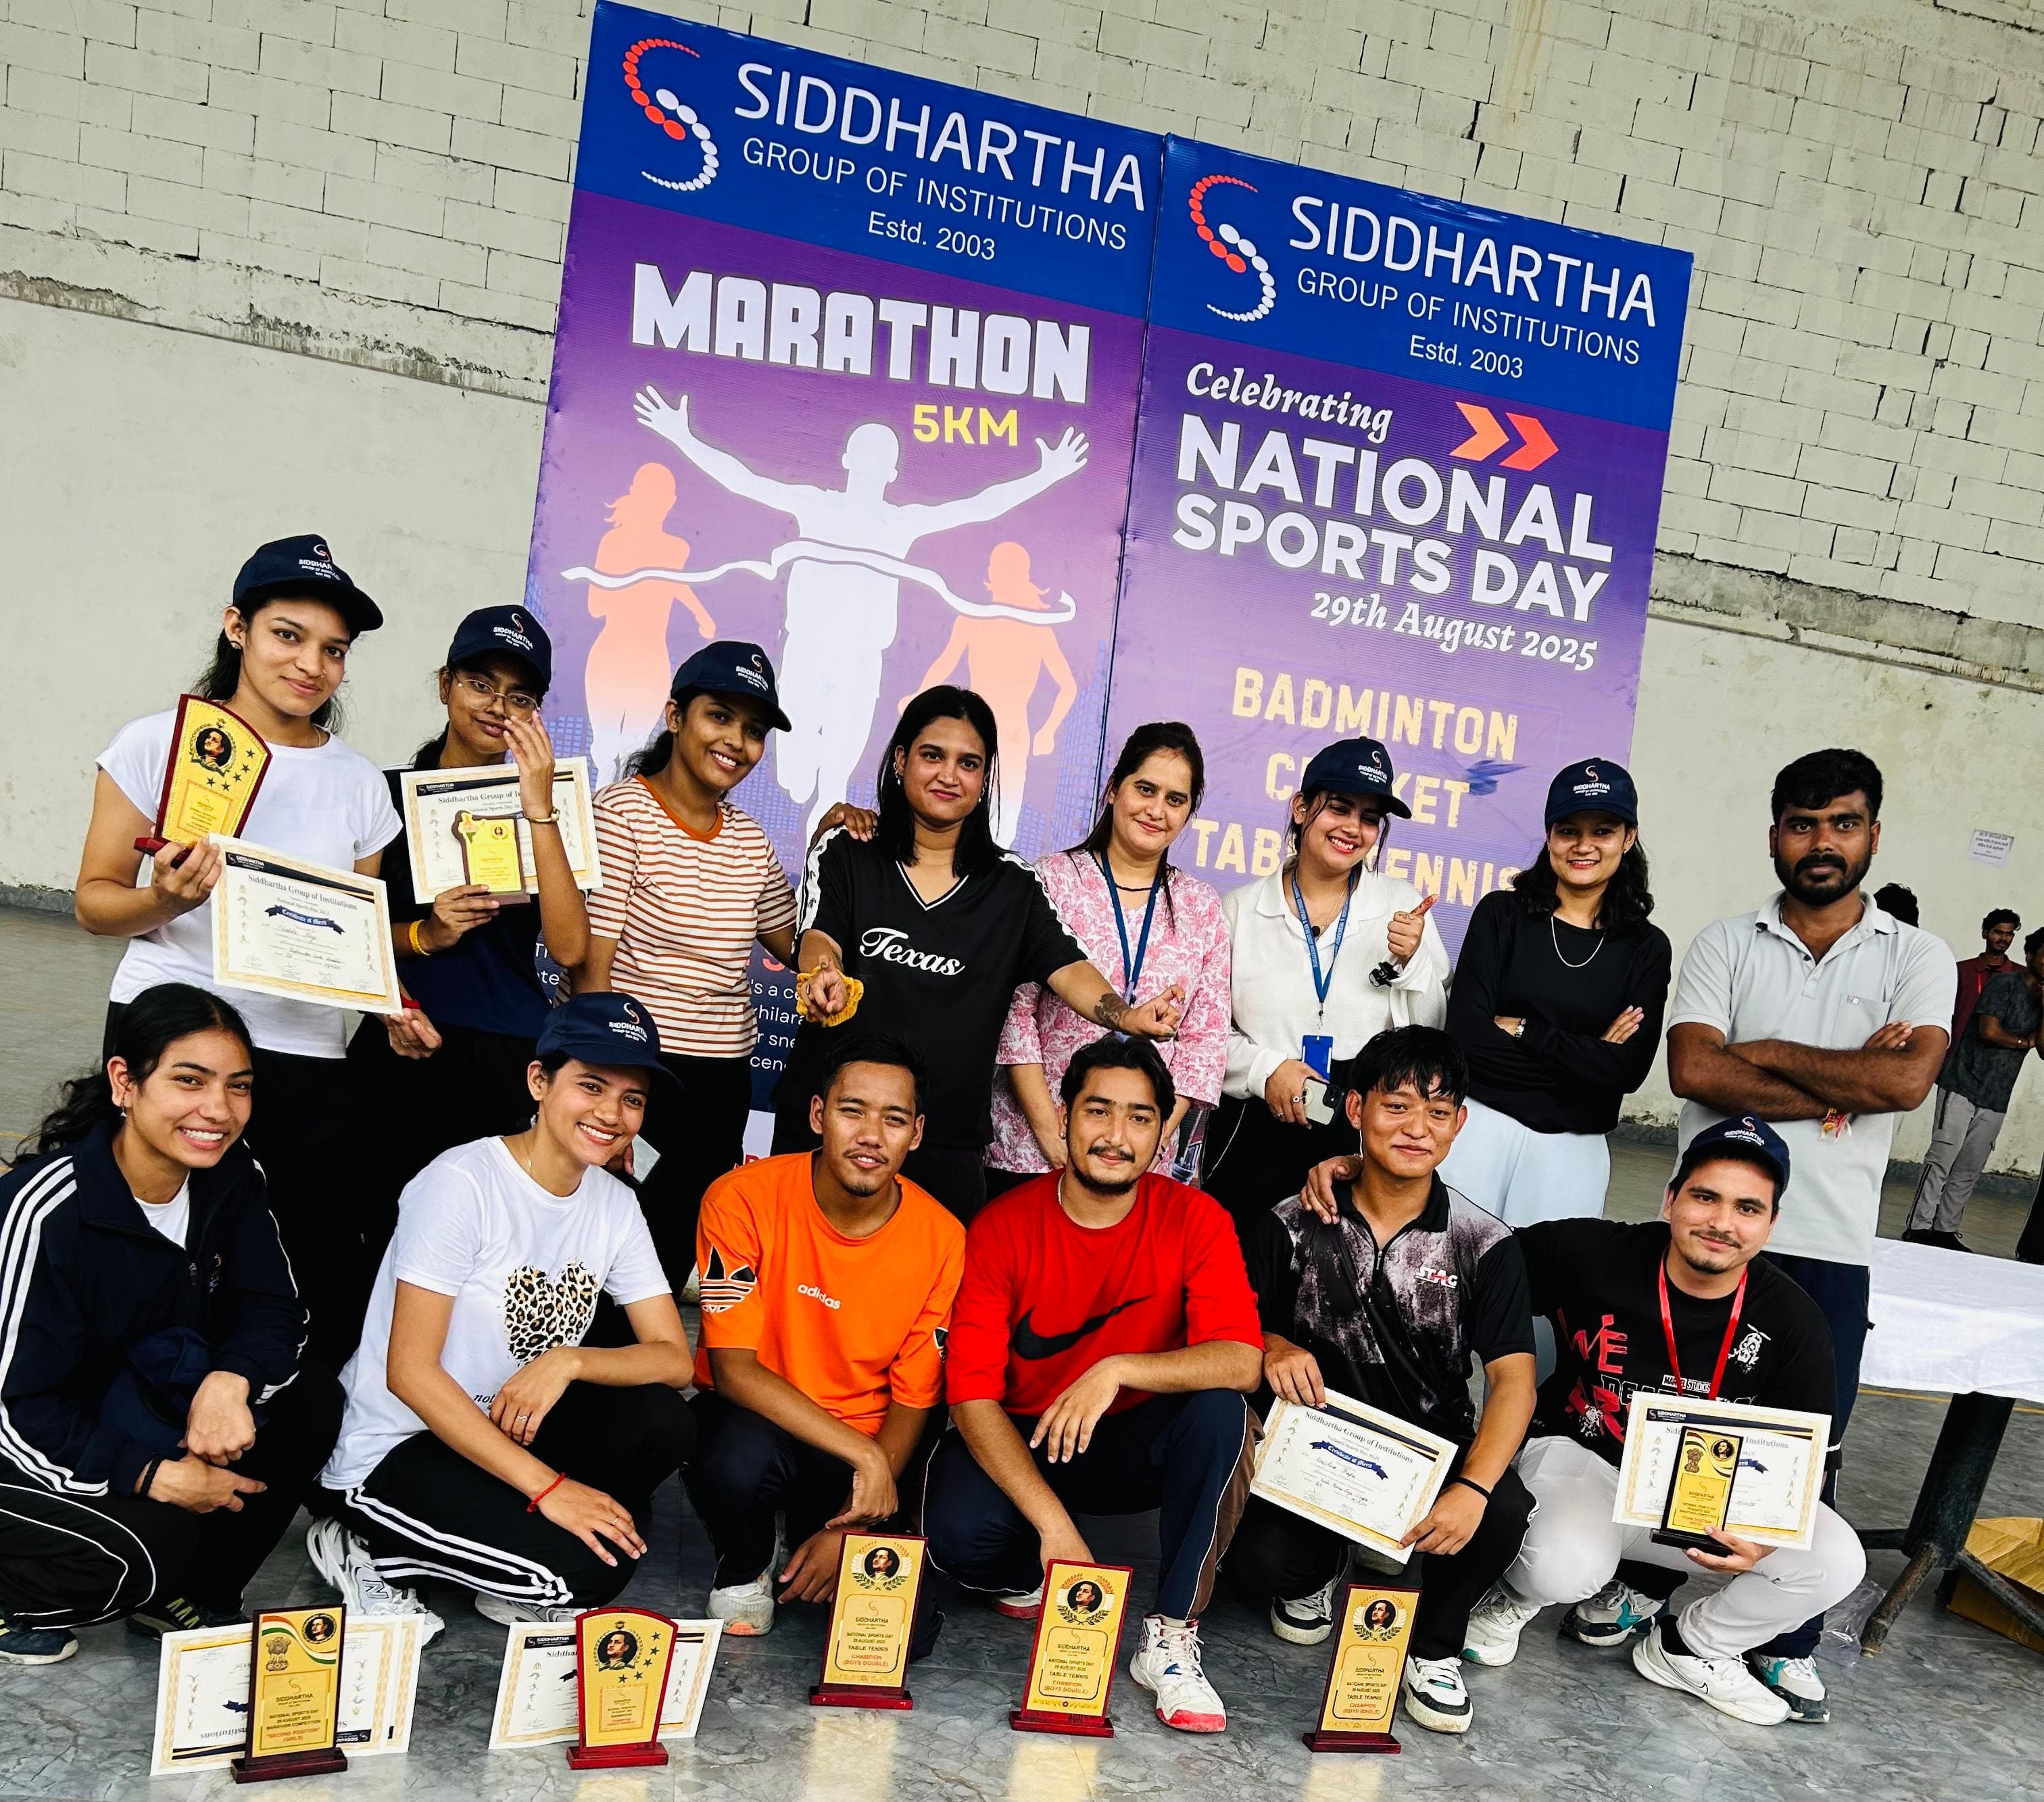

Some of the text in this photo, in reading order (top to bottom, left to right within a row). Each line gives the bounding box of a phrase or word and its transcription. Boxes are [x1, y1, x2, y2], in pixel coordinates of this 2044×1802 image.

[735, 63, 1145, 211] SIDDHARTHA
[744, 138, 1127, 249] GROUP OF INSTITUTIONS
[869, 211, 996, 260] Estd. 2003
[1290, 196, 1655, 327] SIDDHARTHA
[632, 263, 1090, 404] MARATHON
[1298, 268, 1640, 364] GROUP OF INSTITUTIONS
[1410, 335, 1524, 379] Estd. 2003
[913, 404, 1018, 447] 5KM
[1187, 362, 1393, 444] Celebrating
[1177, 414, 1613, 563] NATIONAL
[1172, 493, 1609, 623] SPORTS DAY
[1310, 592, 1599, 671] 29th August 2025
[1232, 666, 1519, 762] BADMINTON
[438, 795, 479, 804] Siddhartha
[247, 874, 287, 892] Siddhartha
[288, 885, 310, 898] Group
[311, 892, 319, 900] of
[320, 891, 358, 911] Institutions
[859, 927, 966, 976] Texas
[797, 1284, 842, 1311] adidas
[1305, 1411, 1342, 1432] Siddhartha
[1344, 1428, 1366, 1442] Group
[1375, 1441, 1414, 1464] Institutions
[1746, 1436, 1789, 1448] Institutions
[1057, 1643, 1090, 1651] SIDDHARTHA
[275, 1693, 314, 1703] SIDDHARTHA
[1052, 1680, 1083, 1688] CHAMPION
[1063, 1686, 1088, 1695] DOUBLE)
